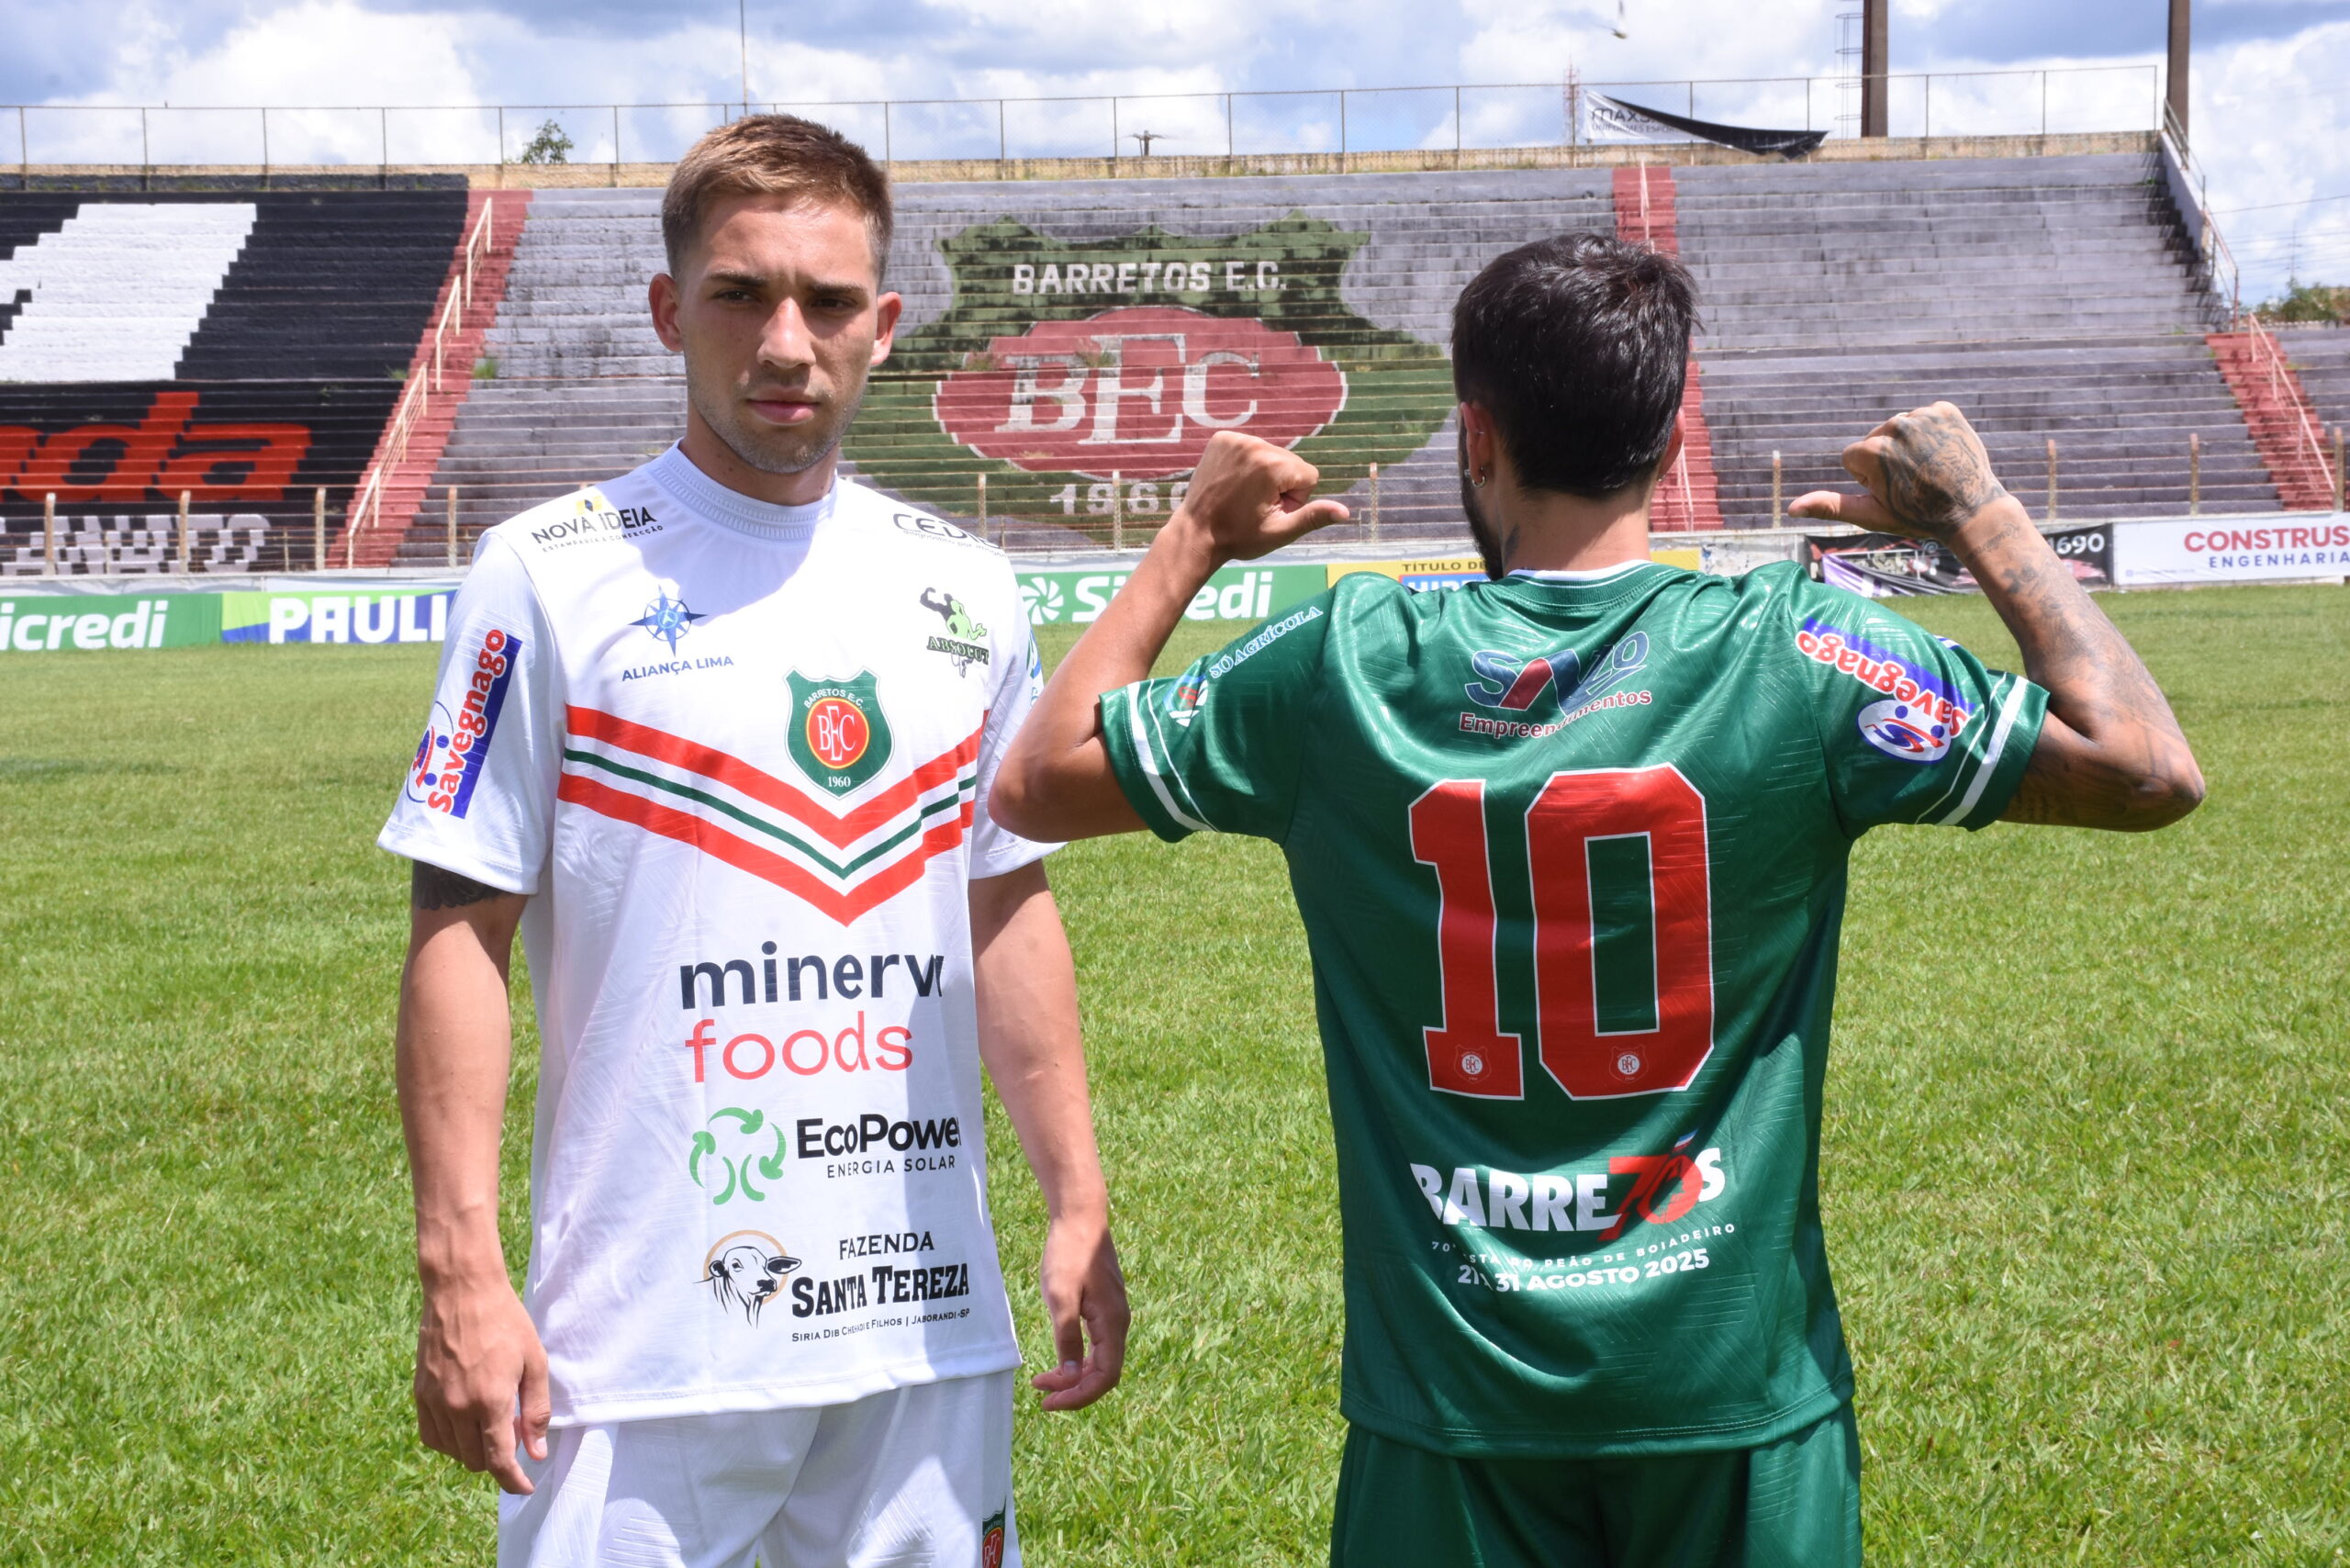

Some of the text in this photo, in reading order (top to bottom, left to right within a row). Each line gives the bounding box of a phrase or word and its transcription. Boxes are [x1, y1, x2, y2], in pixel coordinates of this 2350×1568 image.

[1013, 261, 1287, 296] BARRETOS E.C.
[994, 334, 1259, 445] BEC
[0, 392, 312, 501] da
[531, 506, 658, 544] NOVA IDEIA
[610, 524, 664, 541] CONFECÇÃO
[893, 513, 1002, 549] CEDI
[1402, 560, 1461, 572] TÍTULO
[2209, 551, 2350, 568] ENGENHARIA
[1071, 571, 1273, 622] Sedi
[1234, 605, 1324, 666] AGRÍCOLA
[621, 655, 734, 681] ALIANÇA LIMA
[1796, 631, 1970, 738] Savegnago
[803, 688, 864, 709] BARRETOS E.C.
[1460, 690, 1652, 739] Empreendimentos
[427, 629, 507, 814] Savegnago
[816, 705, 856, 761] BEC
[827, 776, 851, 788] 1960
[1408, 762, 1715, 1101] 10
[685, 1010, 913, 1083] foods
[796, 1114, 961, 1159] EcoPowe
[827, 1154, 956, 1180] ENERGIA SOLAR
[839, 1230, 935, 1260] FAZENDA
[1463, 1252, 1500, 1264] STA
[1544, 1255, 1593, 1268] PEÃO
[1604, 1252, 1626, 1263] DE
[1636, 1223, 1735, 1258] BOIADEIRO
[791, 1262, 970, 1318] SANTA TEREZA
[1526, 1266, 1640, 1291] AGOSTO
[1644, 1248, 1710, 1279] 2025
[791, 1331, 822, 1342] SIRIA
[823, 1328, 840, 1339] DIB
[871, 1317, 902, 1328] FILHOS
